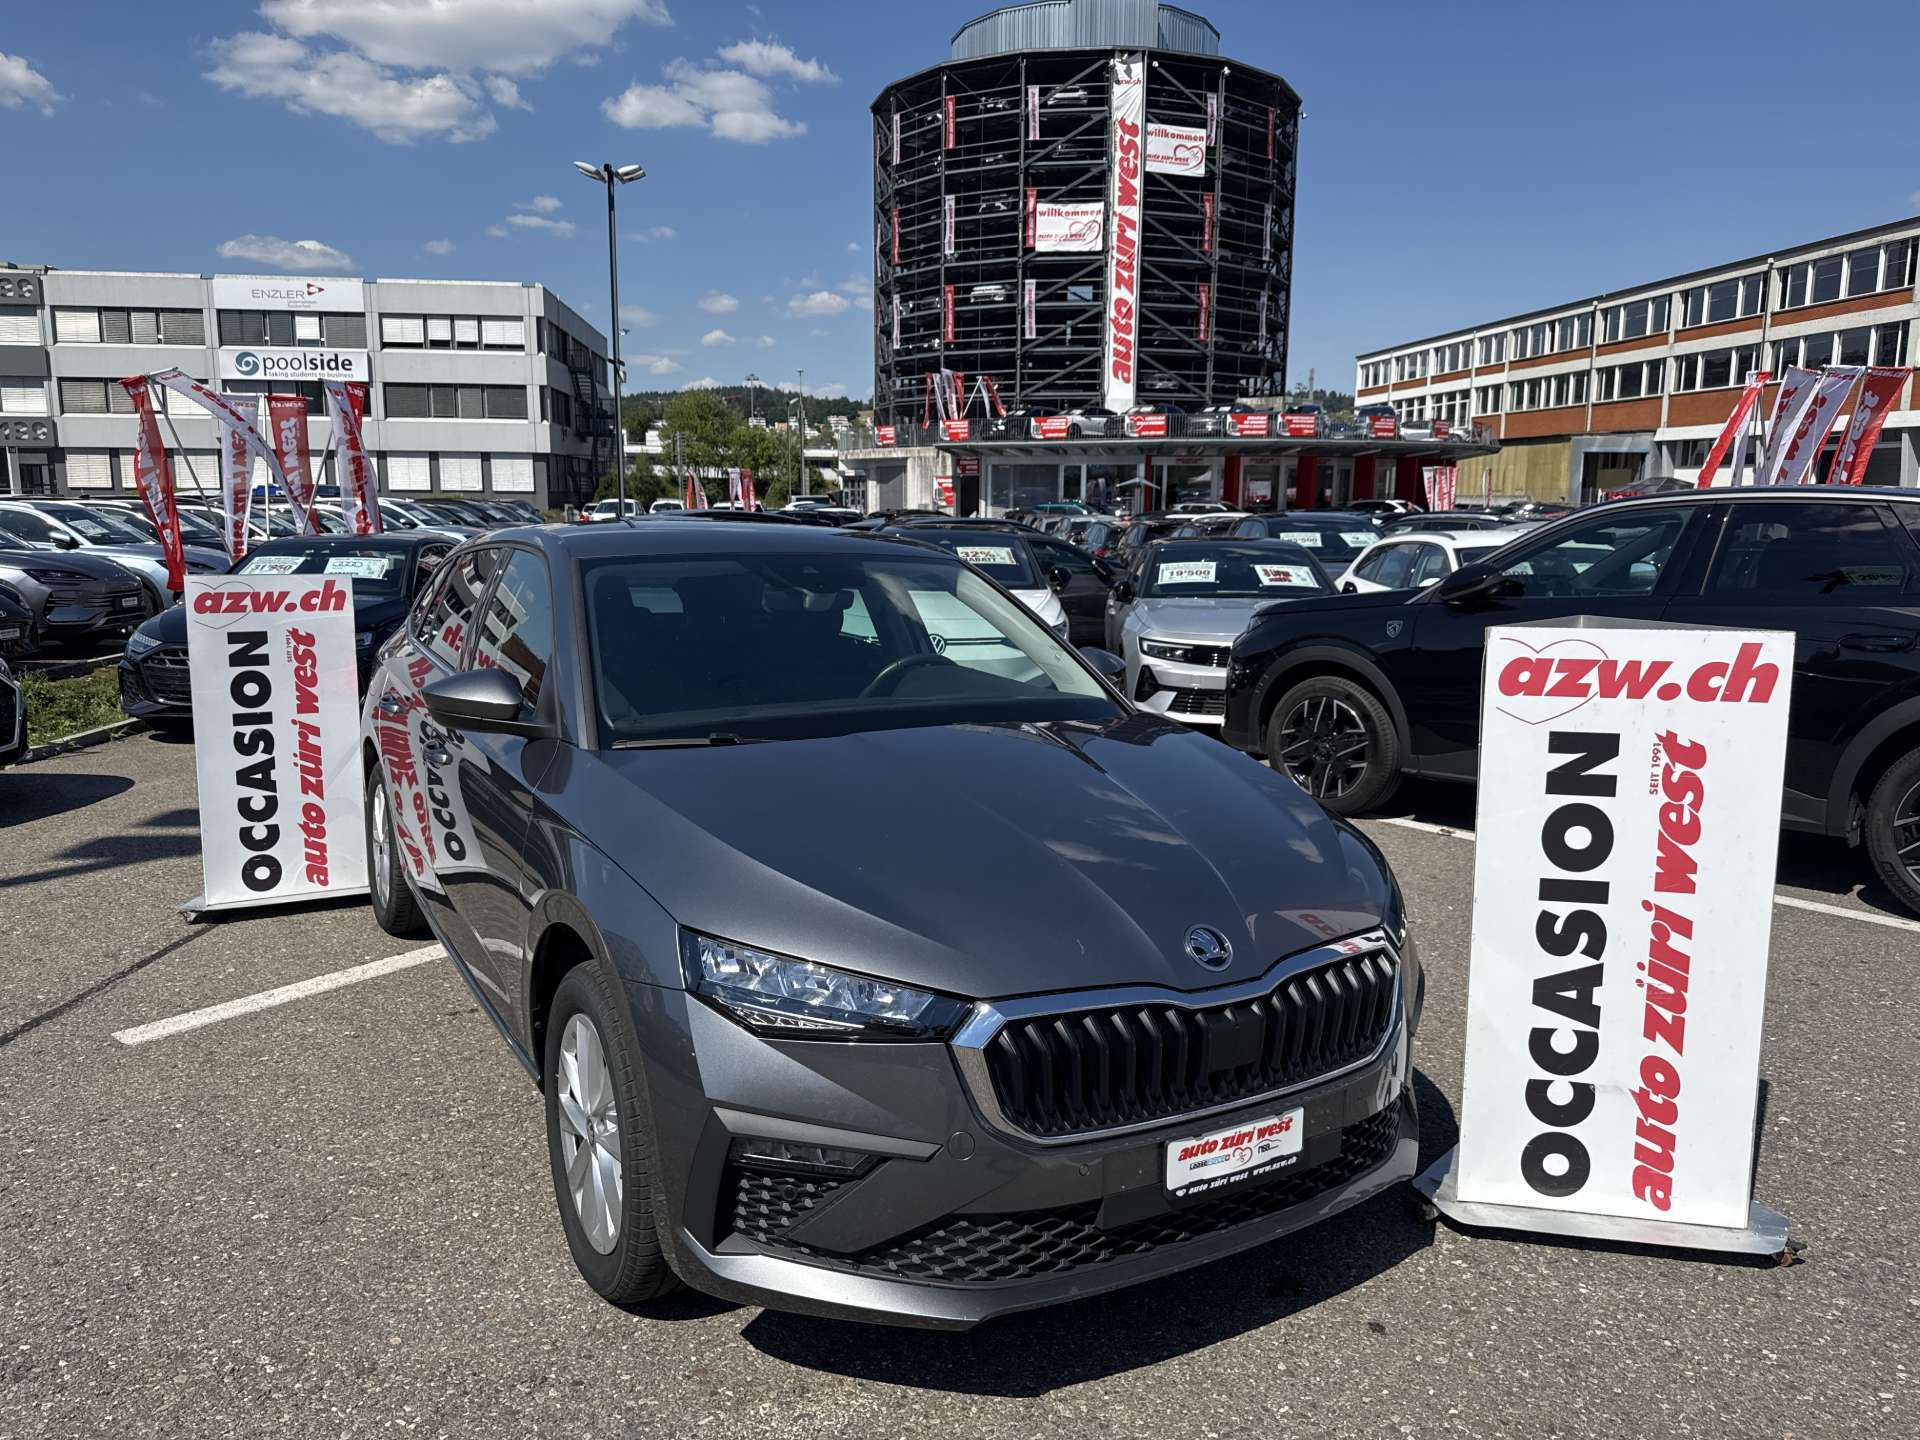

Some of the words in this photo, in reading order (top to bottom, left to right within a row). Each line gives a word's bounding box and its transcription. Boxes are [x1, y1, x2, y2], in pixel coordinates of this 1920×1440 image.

[1117, 117, 1140, 206] west
[1146, 128, 1205, 142] willkommen
[1038, 207, 1102, 218] willkommen
[1111, 211, 1138, 297] züri
[251, 289, 305, 299] ENZLER
[263, 352, 353, 376] poolside
[268, 371, 289, 379] taking
[327, 371, 354, 379] business
[1110, 298, 1134, 384] auto
[193, 580, 347, 615] azw.ch
[286, 627, 321, 715] west
[1498, 642, 1780, 704] azw.ch
[227, 630, 283, 893] OCCASION
[292, 717, 325, 801] züri
[1649, 771, 1660, 796] SEIT
[1651, 742, 1662, 768] 1991
[297, 802, 330, 887] auto
[1654, 729, 1708, 896] west
[1520, 730, 1621, 1199] OCCASION
[1636, 899, 1695, 1057] züri
[1178, 1140, 1219, 1162] auto
[1219, 1127, 1257, 1151] züri
[1256, 1116, 1293, 1141] west
[1631, 1055, 1682, 1212] auto
[1188, 1183, 1208, 1195] auto
[1209, 1177, 1229, 1189] züri
[1229, 1171, 1249, 1183] west
